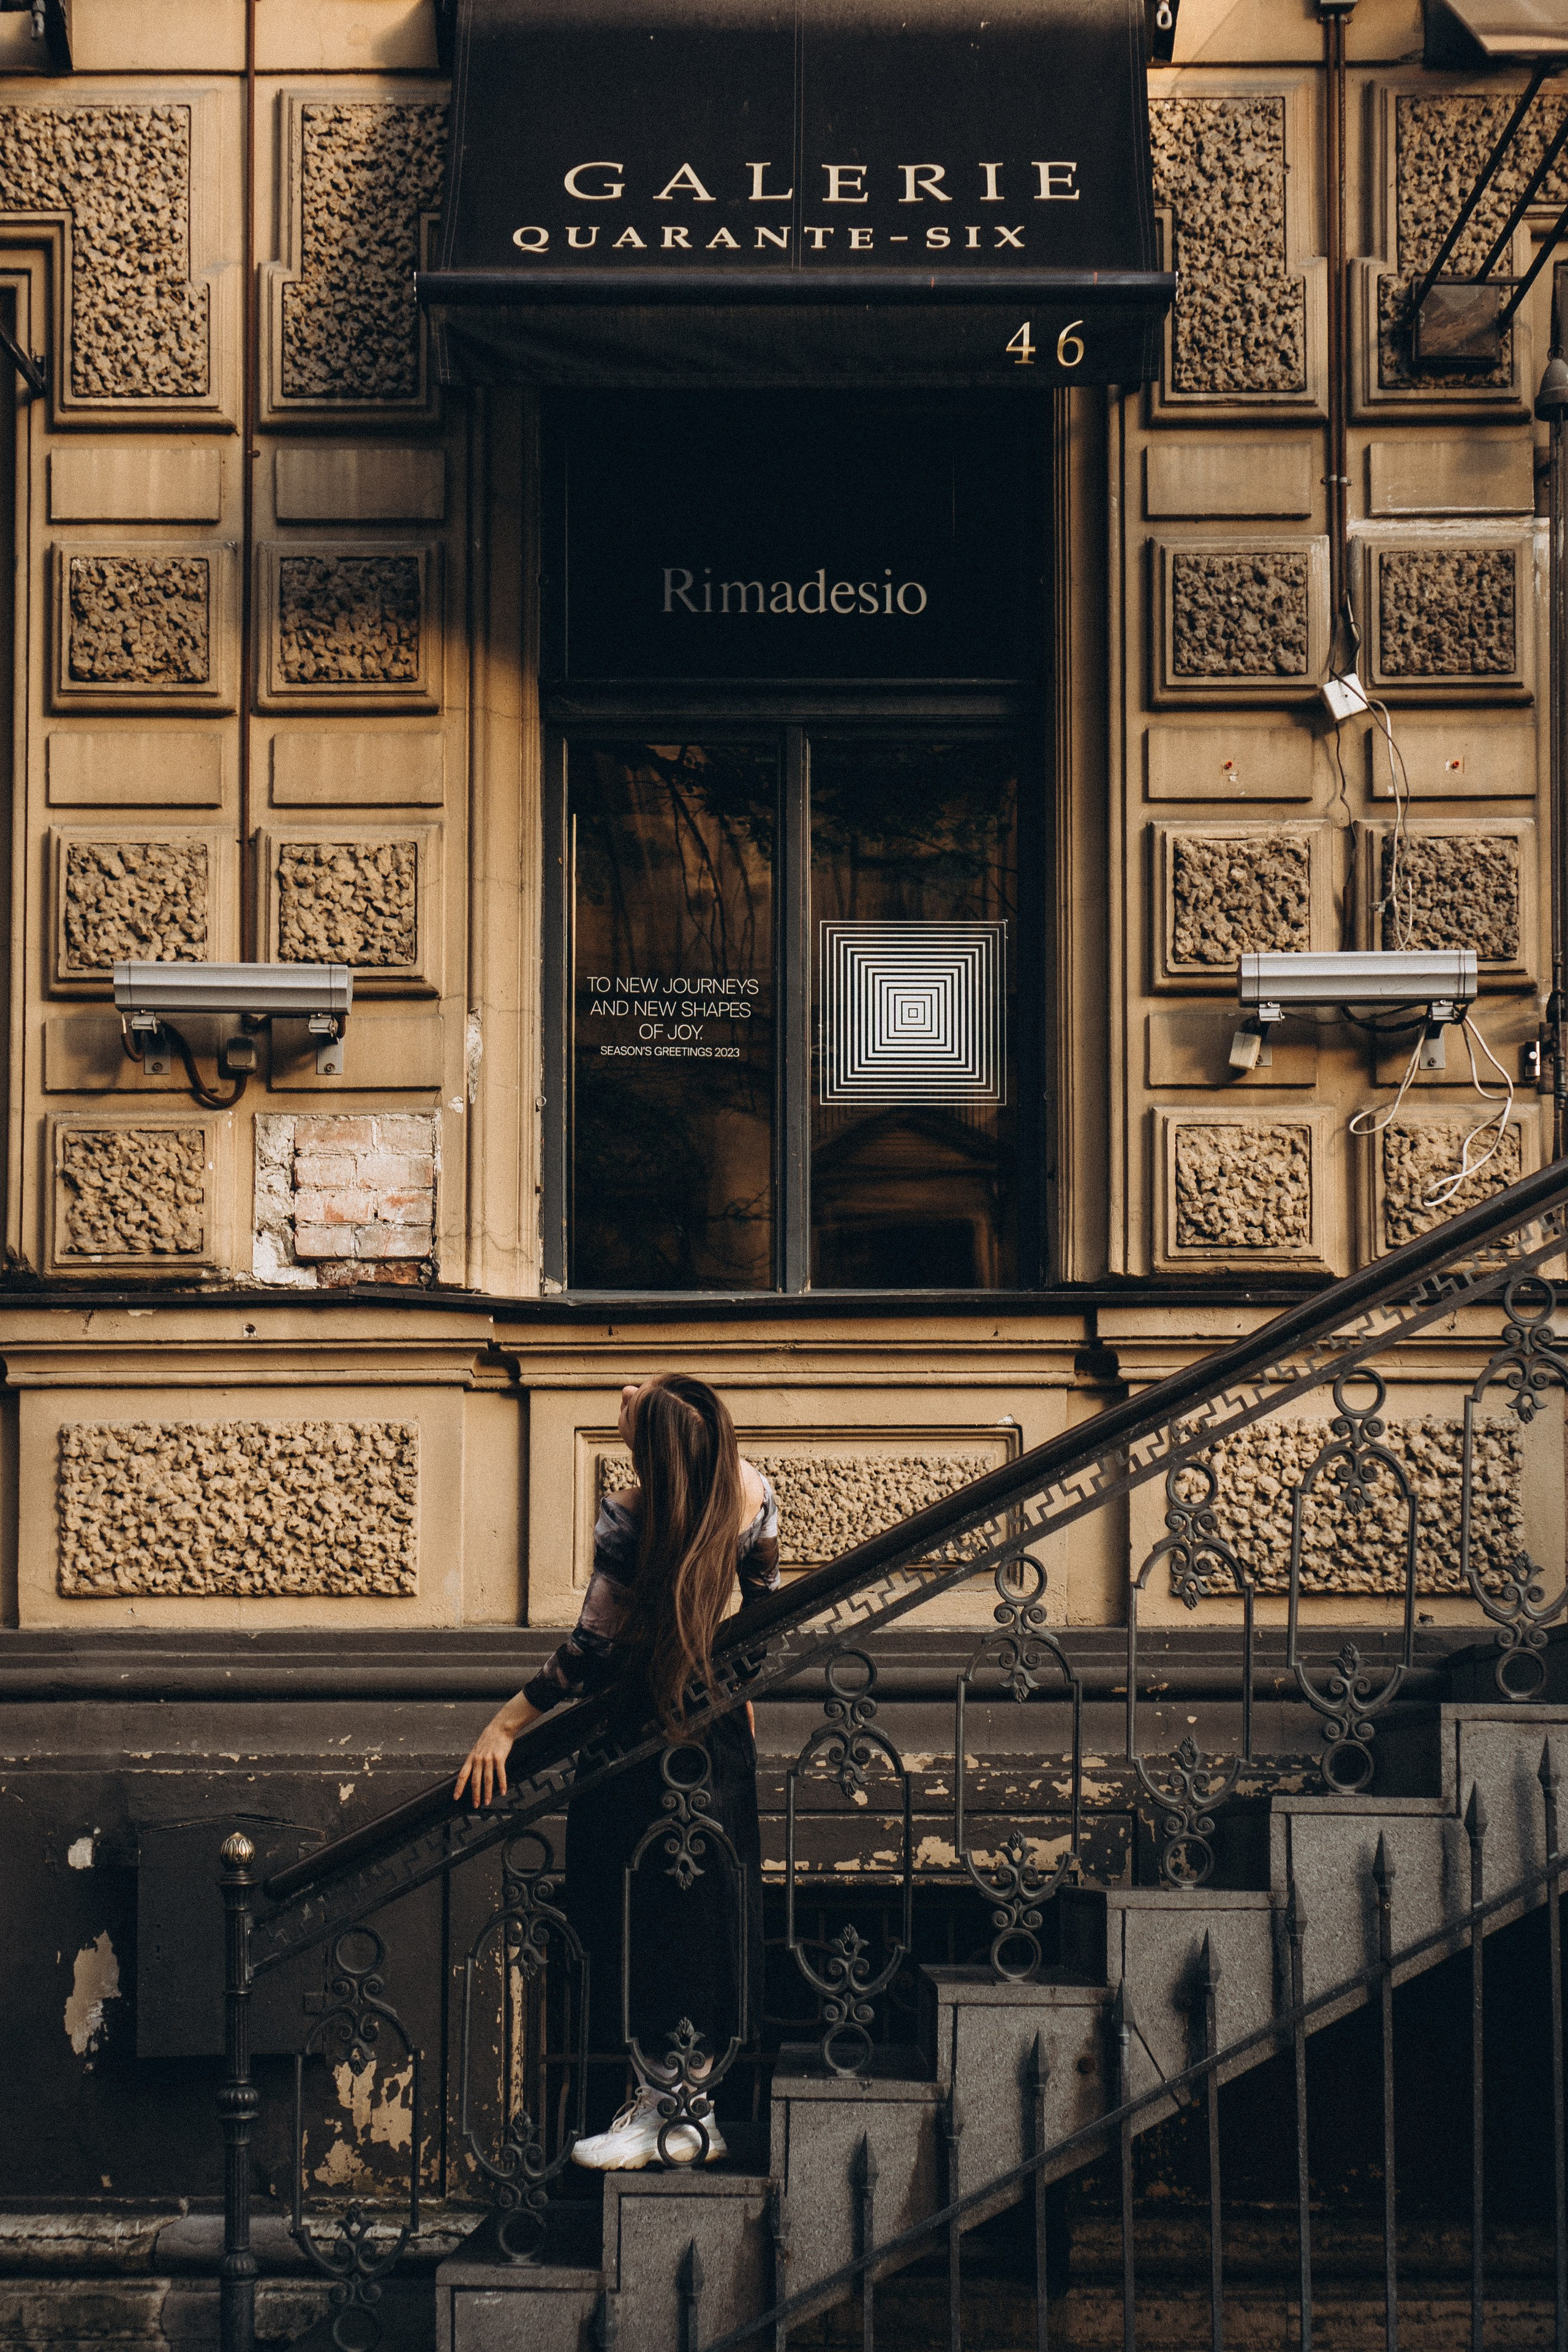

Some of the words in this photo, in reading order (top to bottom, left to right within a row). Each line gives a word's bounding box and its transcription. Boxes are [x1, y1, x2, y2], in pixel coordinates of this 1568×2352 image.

[563, 160, 1080, 203] GALERIE
[512, 225, 1025, 254] QUARANTE-SIX
[1005, 320, 1085, 368] 46
[662, 567, 928, 616] Rimadesio
[586, 976, 611, 992] TO
[616, 977, 658, 993] NEW
[663, 978, 759, 995] JOURNEYS
[590, 1000, 629, 1016] AND
[635, 1001, 677, 1017] NEW
[681, 1001, 752, 1018] SHAPES
[639, 1023, 663, 1039] OF
[667, 1024, 703, 1041] JOY.
[600, 1046, 652, 1056] SEASON'S
[654, 1046, 712, 1057] GREETINGS
[715, 1047, 740, 1057] 2023
